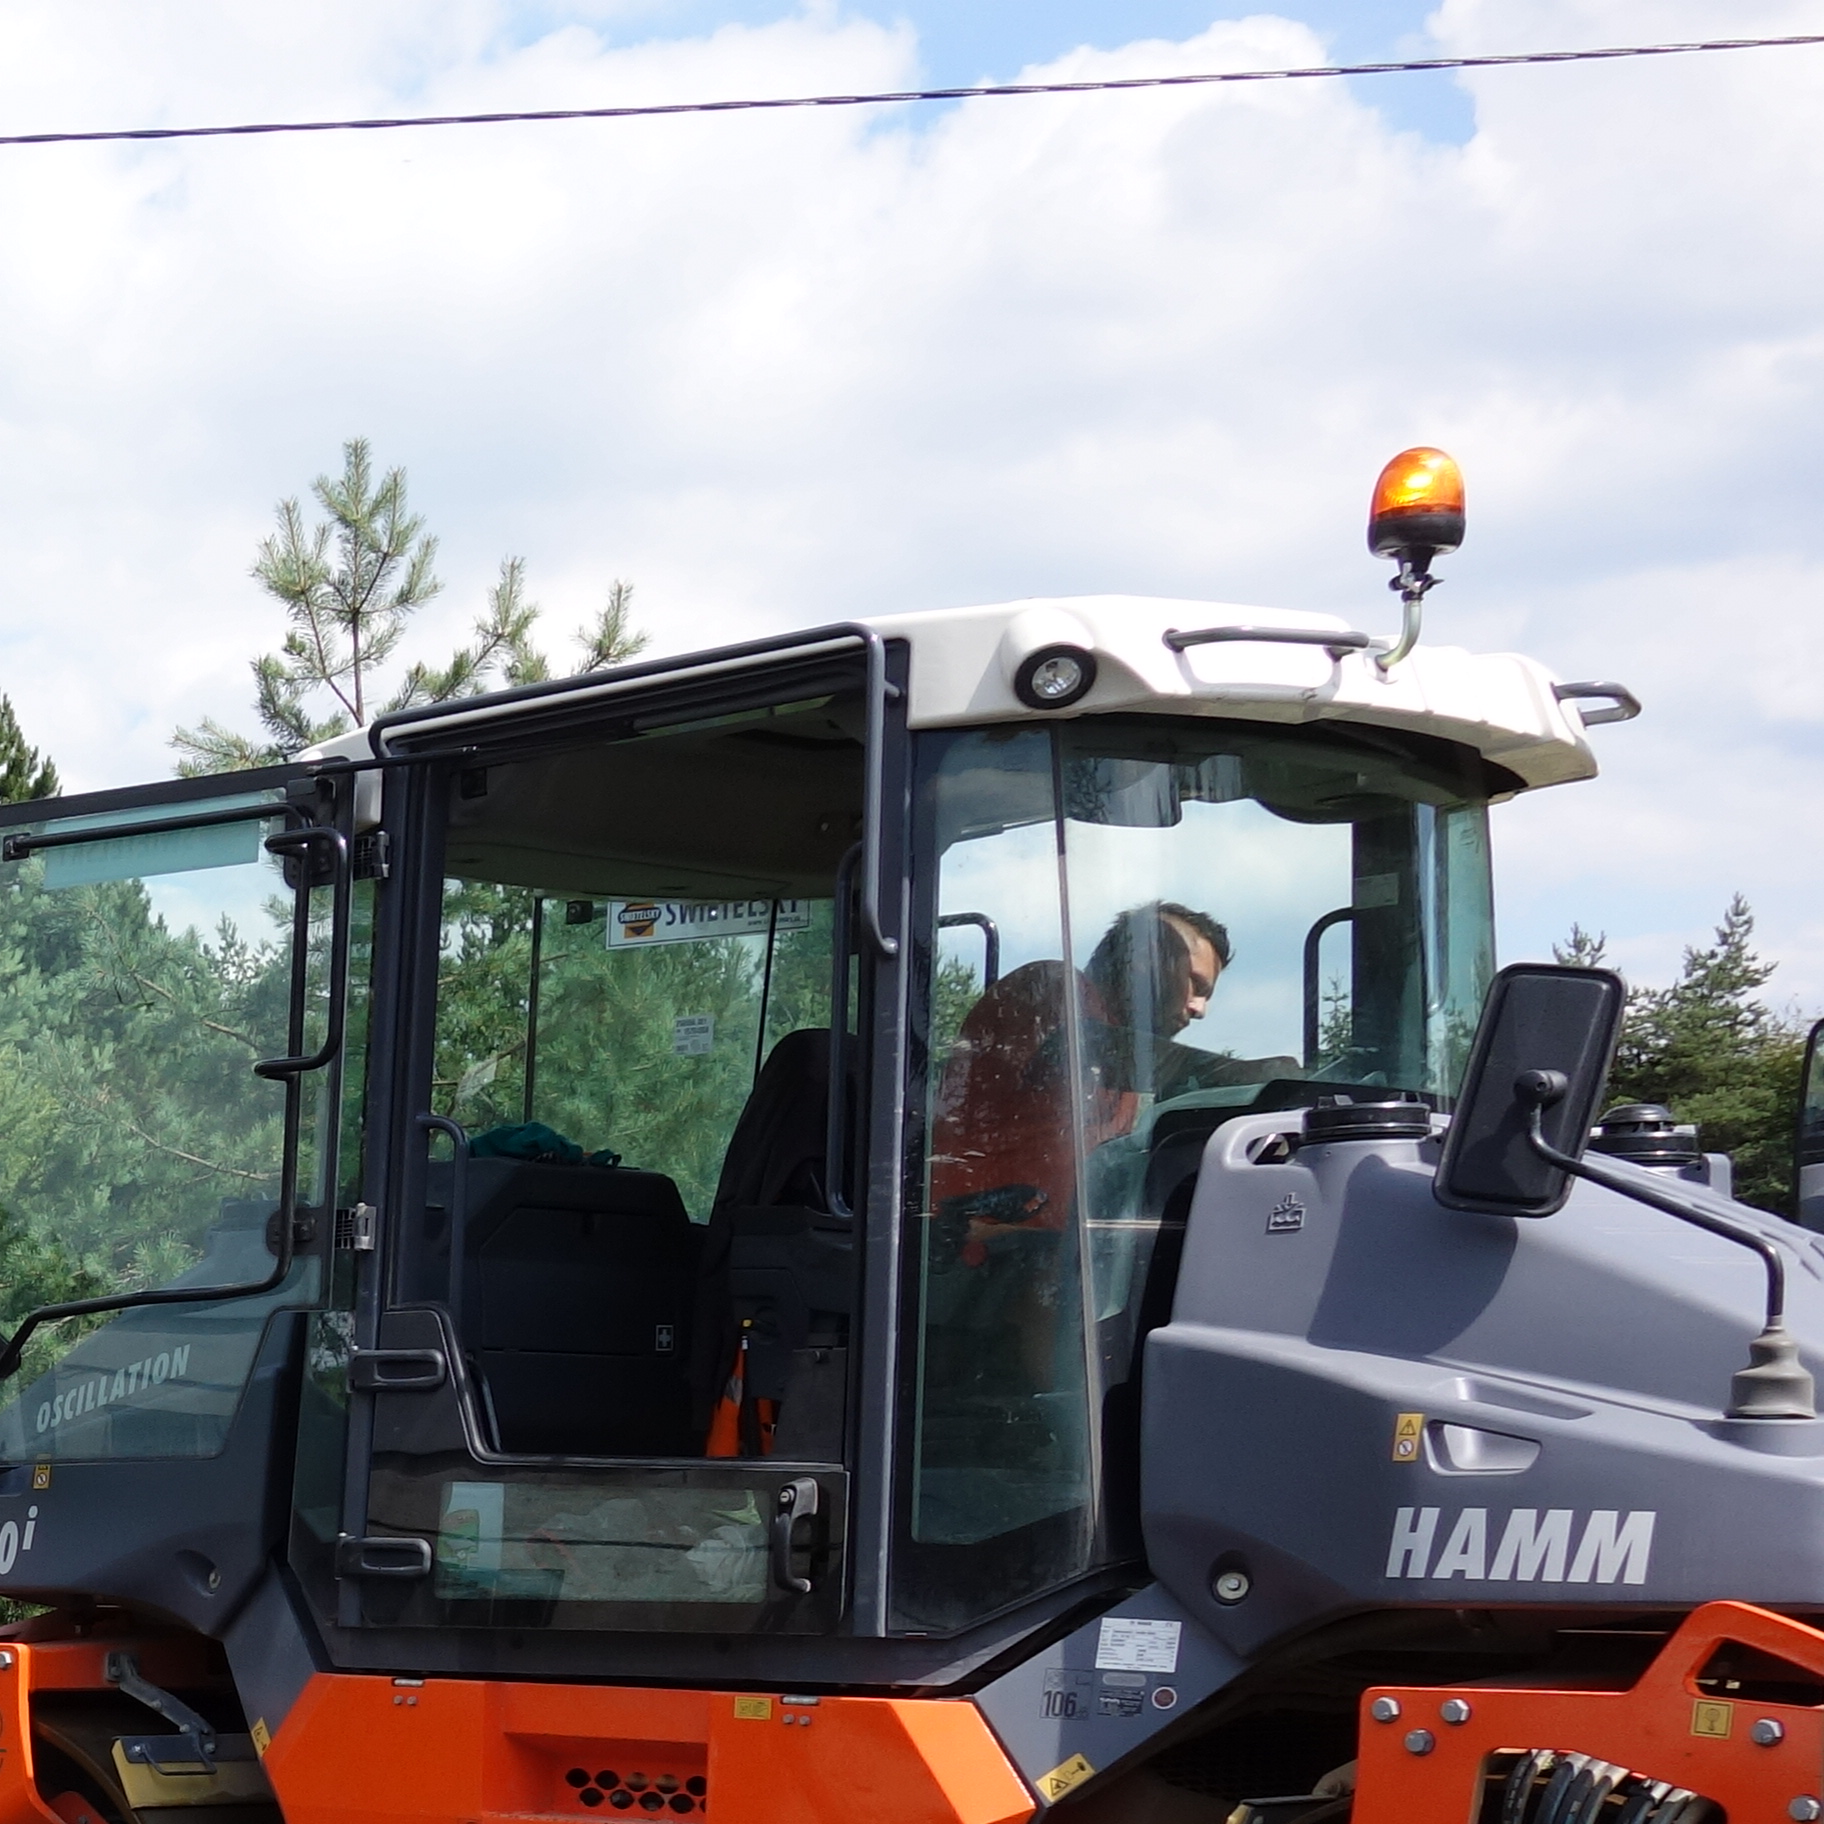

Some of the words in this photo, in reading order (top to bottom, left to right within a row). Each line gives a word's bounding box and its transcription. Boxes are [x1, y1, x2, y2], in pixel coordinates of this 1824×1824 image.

[36, 1344, 191, 1433] OSCILLATION
[1385, 1506, 1657, 1585] HAMM
[1043, 1689, 1078, 1717] 106
